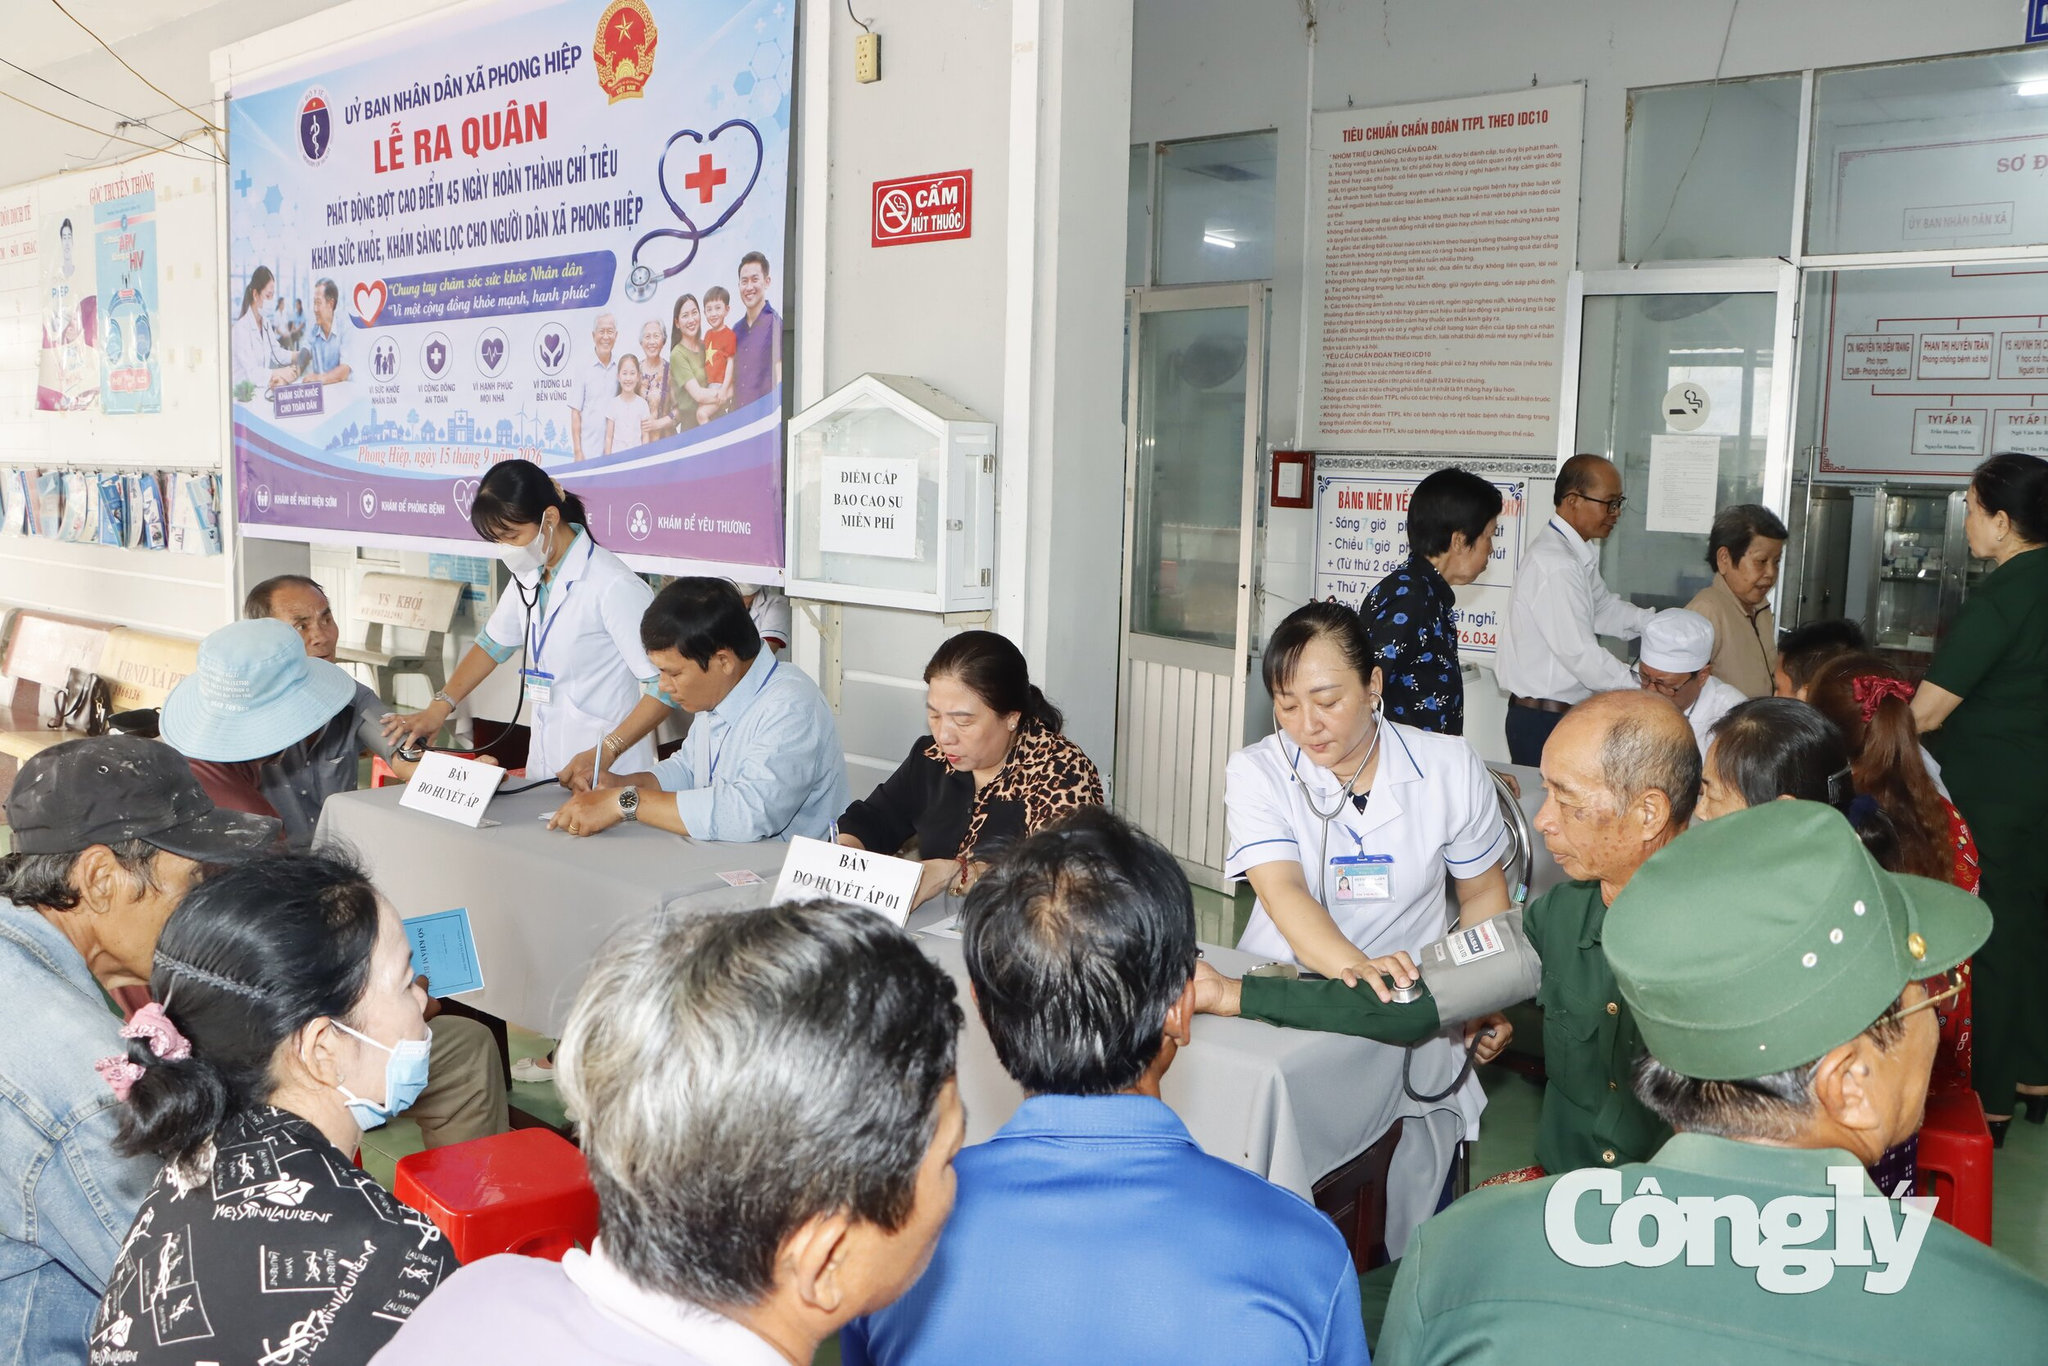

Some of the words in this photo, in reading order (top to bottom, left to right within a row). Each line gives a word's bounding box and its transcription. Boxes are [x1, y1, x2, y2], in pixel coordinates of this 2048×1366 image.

[345, 96, 361, 125] UỶ
[364, 99, 390, 121] BAN
[394, 82, 431, 114] NHÂN
[434, 74, 463, 103] DÂN
[465, 64, 485, 94] XÃ
[488, 55, 541, 87] PHONG
[544, 42, 582, 76] HIỆP
[1343, 126, 1364, 143] TIÊU
[1366, 120, 1399, 140] CHUẨN
[1401, 117, 1429, 137] CHẨN
[1461, 115, 1485, 132] TTPL
[1488, 113, 1515, 129] THEO
[1517, 109, 1549, 126] IDC10
[373, 121, 404, 174] LỄ
[413, 123, 453, 166] RA
[461, 99, 548, 159] QUÂN
[1997, 153, 2026, 173] SƠ
[2033, 156, 2048, 172] Đ
[326, 195, 348, 227] PHÁT
[350, 195, 375, 223] ĐỘNG
[377, 190, 395, 219] ĐỢT
[398, 186, 416, 213] CAO
[419, 171, 444, 210] ĐIỂM
[447, 179, 459, 205] 45
[462, 169, 488, 202] NGÀY
[492, 162, 522, 197] HOÀN
[525, 156, 563, 192] THÀNH
[567, 145, 587, 184] CHỈ
[590, 143, 618, 180] TIÊU
[915, 181, 958, 208] CẤM
[911, 212, 929, 233] HÚT
[931, 206, 961, 231] THUỐC
[1908, 215, 1922, 230] ỦY
[1924, 217, 1941, 229] BAN
[1944, 213, 1970, 228] NHÂN
[1972, 212, 1992, 226] DÂN
[1993, 210, 2007, 225] XÃ
[311, 240, 336, 270] KHÁM
[338, 236, 355, 266] SỨC
[358, 231, 385, 266] KHỎE,
[387, 228, 414, 260] KHÁM
[417, 223, 441, 254] SÀNG
[444, 224, 463, 254] LỌC
[467, 221, 487, 249] CHO
[491, 209, 523, 245] NGƯỜI
[526, 206, 549, 240] DÂN
[552, 202, 567, 236] XÃ
[571, 204, 610, 233] PHONG
[613, 190, 643, 231] HIỆP
[129, 250, 144, 272] HIV
[423, 281, 438, 296] tay
[440, 277, 464, 292] chăm
[467, 275, 483, 288] sóc
[485, 272, 501, 286] sức
[503, 270, 527, 283] khỏe
[530, 265, 558, 281] Nhân
[561, 262, 584, 277] dân
[404, 304, 421, 317] một
[423, 301, 444, 317] cộng
[446, 297, 471, 314] đồng
[473, 294, 496, 309] khỏe
[498, 291, 530, 308] mạnh,
[532, 288, 560, 305] hạnh
[1928, 415, 1943, 425] TYT
[1944, 412, 1958, 425] ẤP
[1961, 415, 1972, 425] 1A
[2008, 415, 2024, 425] TYT
[2026, 412, 2040, 425] ẤP
[358, 446, 386, 467] Phong
[414, 448, 437, 467] ngày
[440, 447, 450, 463] 15
[452, 447, 480, 468] tháng
[484, 448, 490, 464] 9
[381, 501, 397, 512] KHÁM
[398, 497, 406, 512] ĐỂ
[407, 501, 427, 514] PHÒNG
[428, 503, 445, 517] BỆNH
[834, 493, 857, 506] BAO
[860, 494, 885, 507] CAO
[888, 495, 903, 508] SU
[1338, 487, 1363, 510] BẢNG
[1366, 488, 1392, 511] NIÊM
[658, 514, 682, 530] KHÁM
[684, 513, 696, 531] ĐỂ
[698, 516, 714, 532] YÊU
[717, 519, 751, 535] THƯƠNG
[841, 512, 871, 528] MIỄN
[874, 513, 894, 529] PHÍ
[1336, 516, 1360, 532] Sáng
[1371, 518, 1386, 533] giờ
[1335, 535, 1363, 550] Chiều
[1375, 539, 1391, 555] giờ
[1337, 557, 1351, 571] (Từ
[1354, 557, 1371, 571] thứ
[1374, 560, 1379, 572] 2
[1337, 581, 1357, 595] Thứ
[1468, 611, 1498, 628] nghỉ.
[1456, 630, 1497, 646] 76.034
[839, 852, 869, 872] BÀN
[792, 870, 813, 887] ĐO
[814, 876, 864, 900] HUYẾT
[864, 885, 885, 904] ÁP
[885, 894, 900, 910] 01
[383, 1299, 413, 1315] LAUREN
